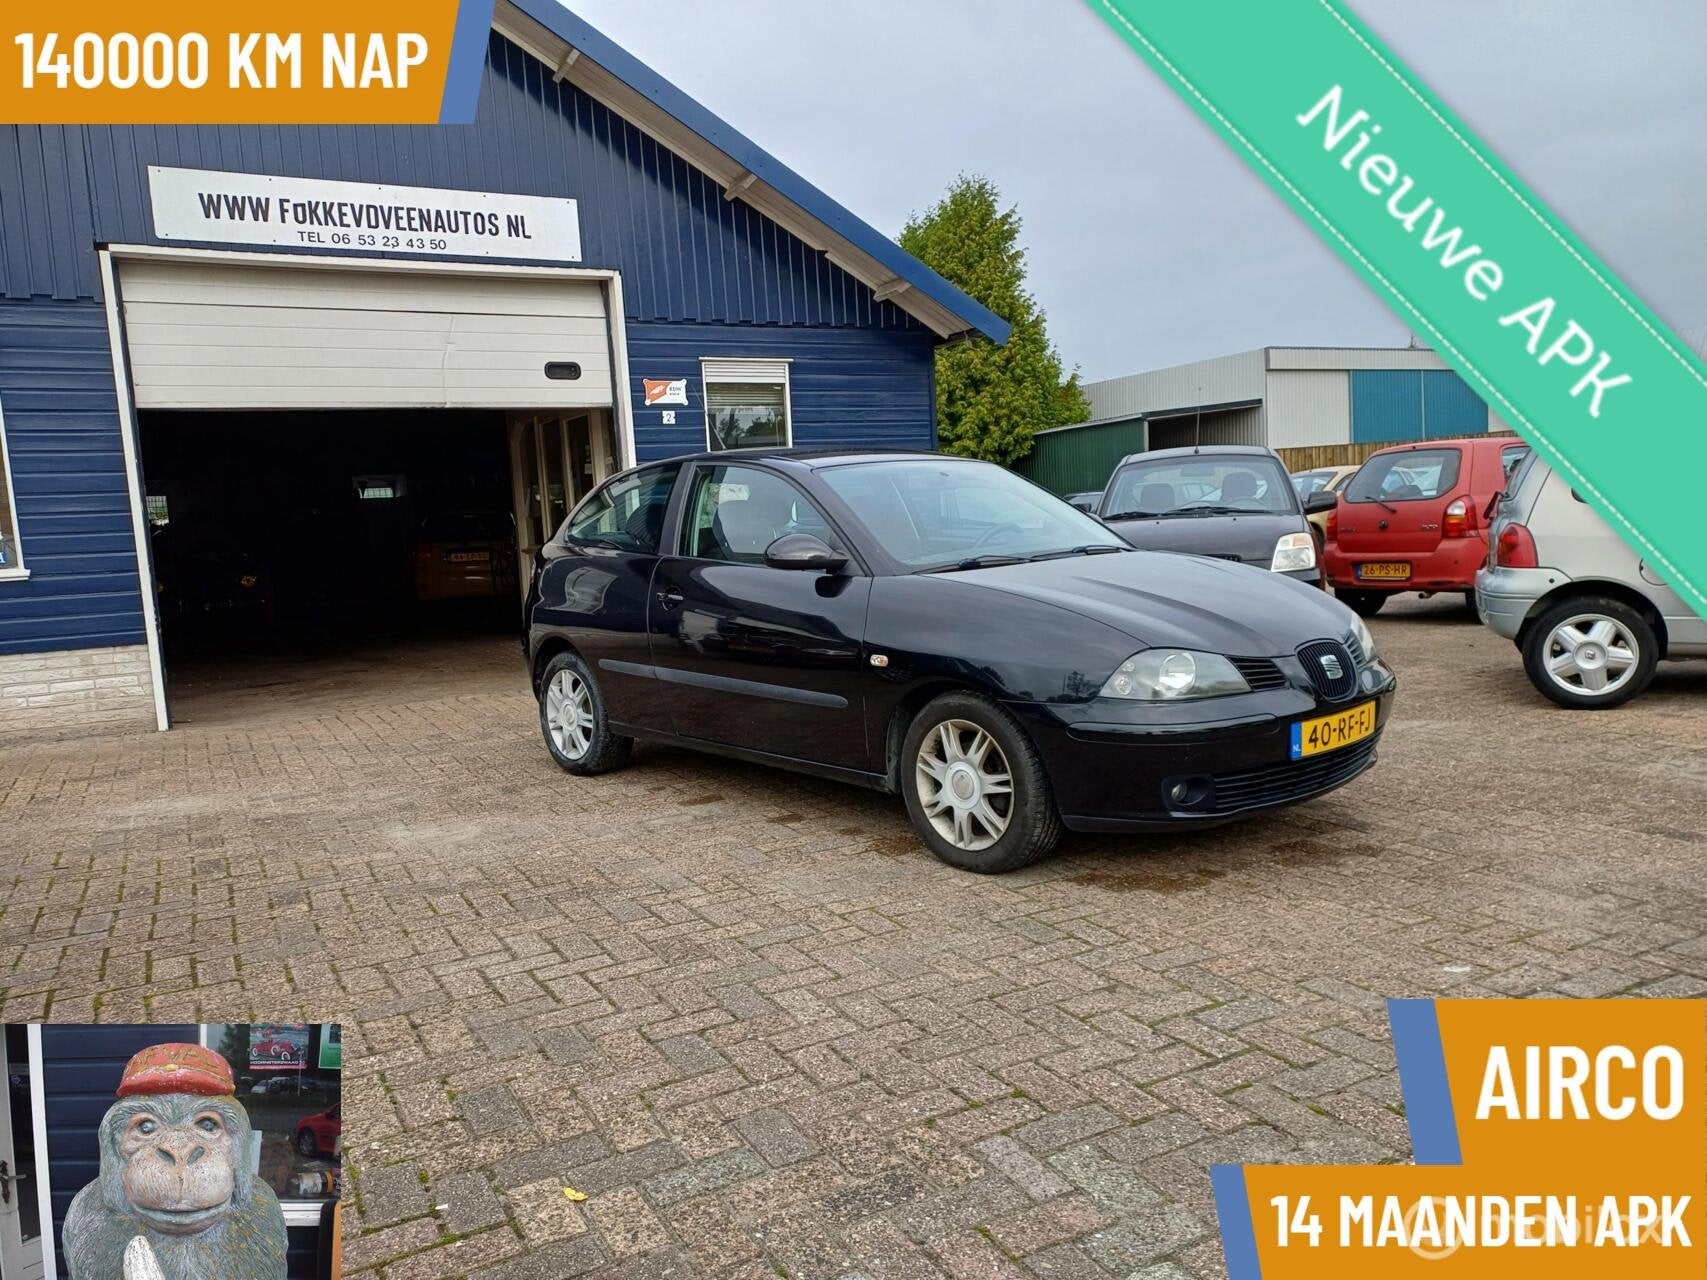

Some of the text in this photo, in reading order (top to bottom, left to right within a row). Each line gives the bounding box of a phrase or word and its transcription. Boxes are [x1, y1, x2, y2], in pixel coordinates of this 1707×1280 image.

[197, 192, 270, 223] WWW
[506, 214, 532, 240] NL
[296, 230, 447, 251] TEL 06 53 23 43 50
[666, 413, 672, 422] 2
[1308, 707, 1372, 749] 40-RF-FJ
